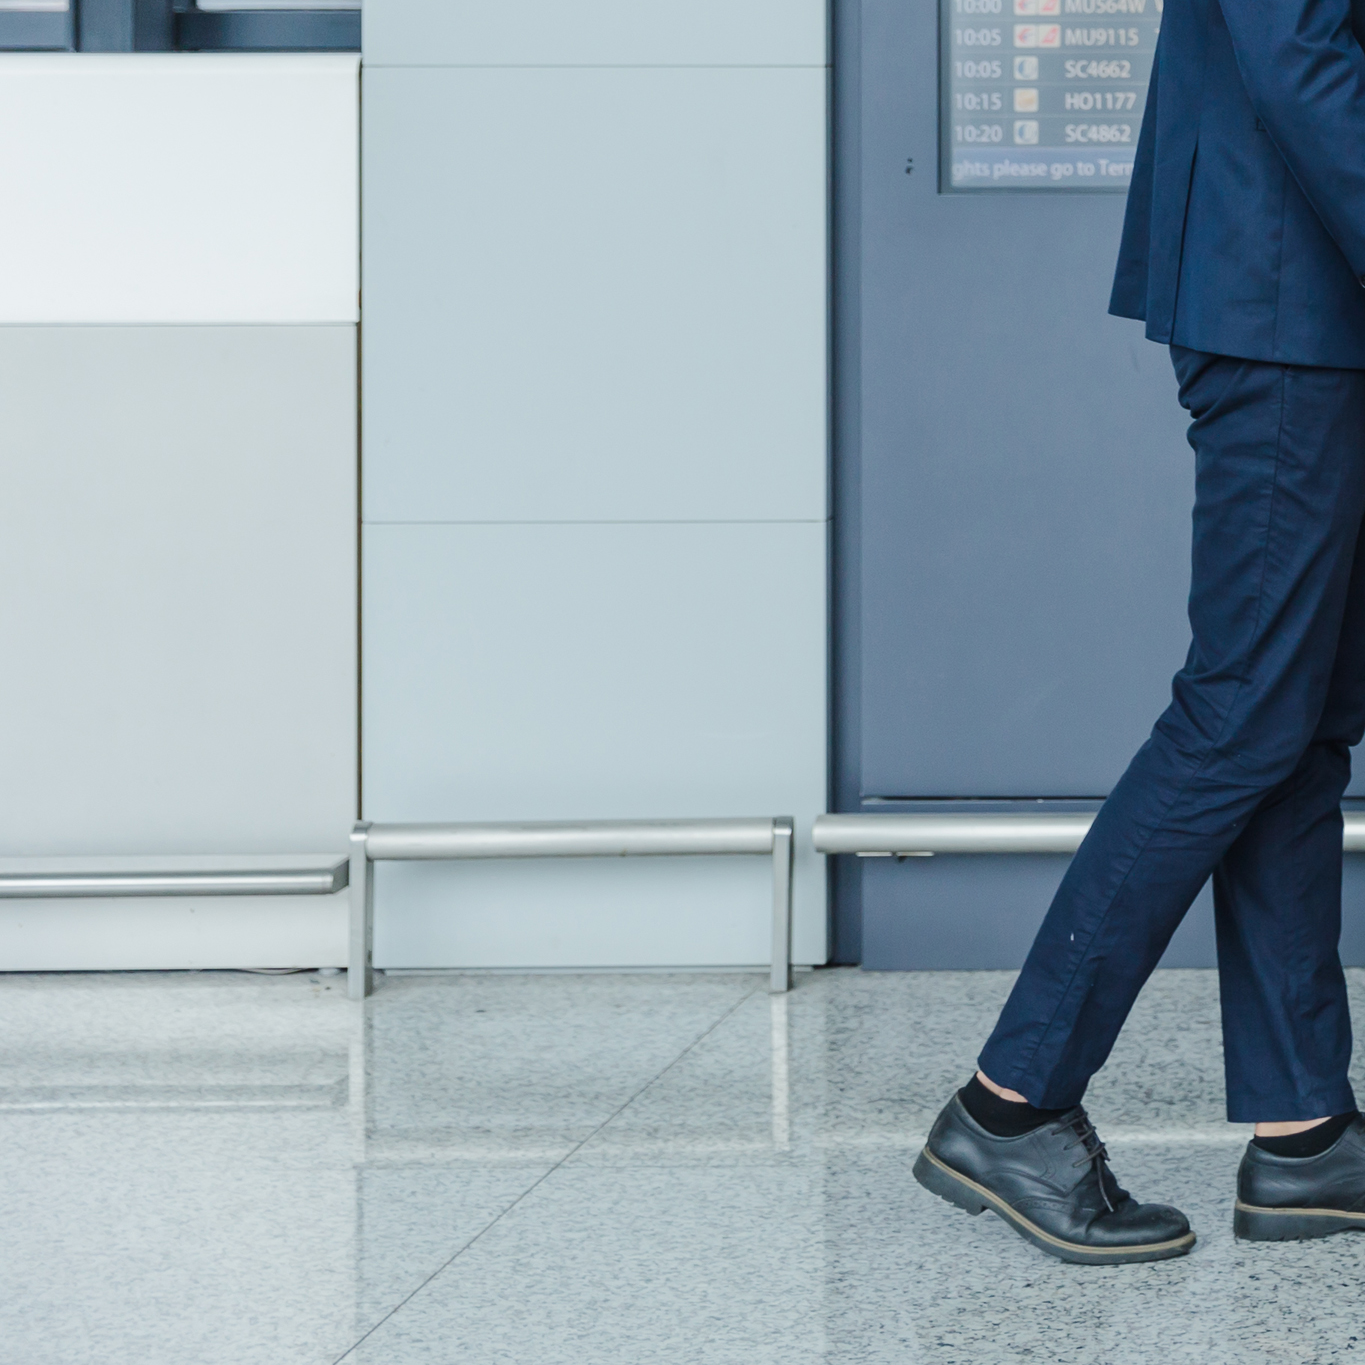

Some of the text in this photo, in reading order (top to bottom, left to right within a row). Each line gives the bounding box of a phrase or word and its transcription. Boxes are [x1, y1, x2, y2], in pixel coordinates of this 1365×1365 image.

[993, 159, 1047, 180] please
[1050, 163, 1073, 180] go
[1077, 161, 1096, 177] to
